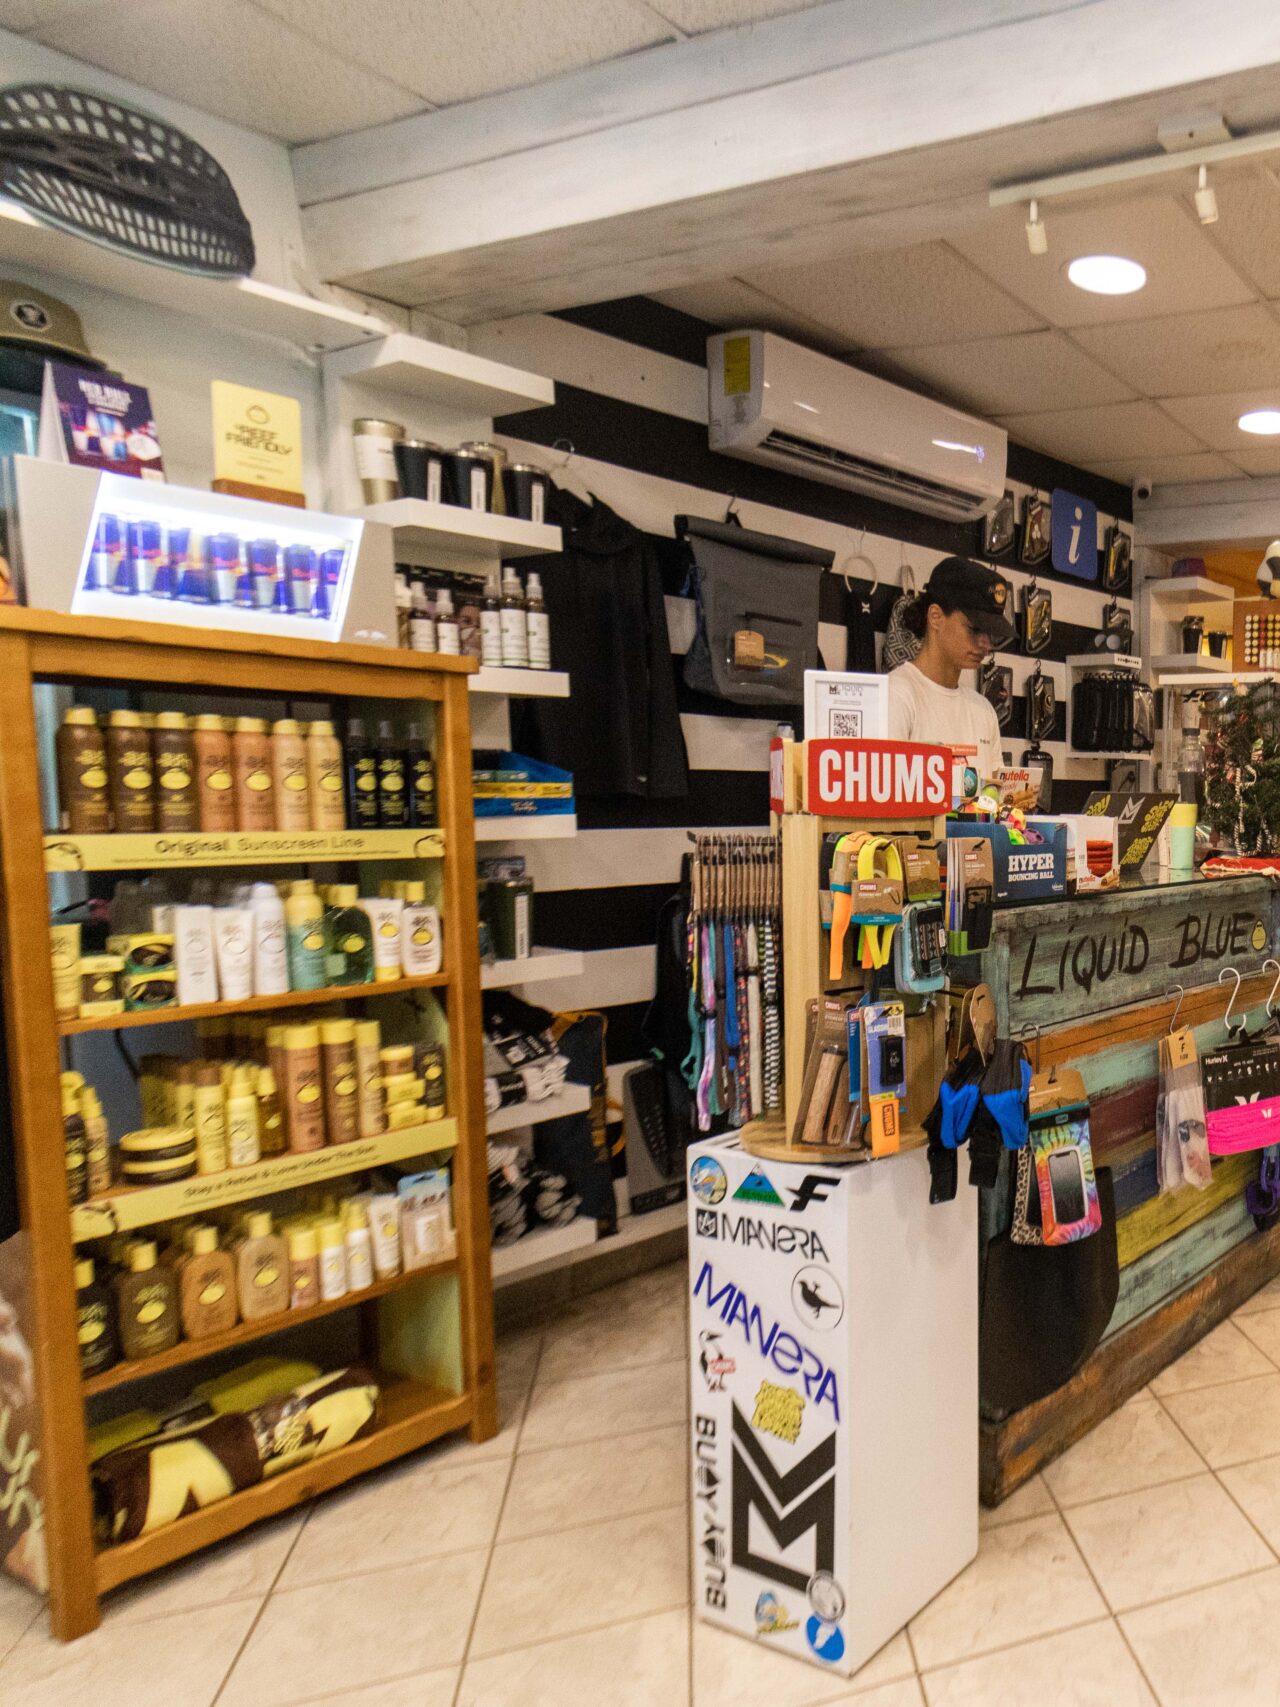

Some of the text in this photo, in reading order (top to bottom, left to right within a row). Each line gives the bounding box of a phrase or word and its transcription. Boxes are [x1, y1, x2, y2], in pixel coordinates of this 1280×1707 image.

[819, 749, 946, 804] CHUMS
[1000, 769, 1029, 782] nutella
[155, 838, 230, 856] Original
[238, 837, 328, 851] Sunscreen
[331, 835, 365, 848] Line
[1008, 853, 1054, 872] HYPER
[1008, 871, 1054, 882] BOUNCING BALL
[1168, 911, 1256, 969] BLUE
